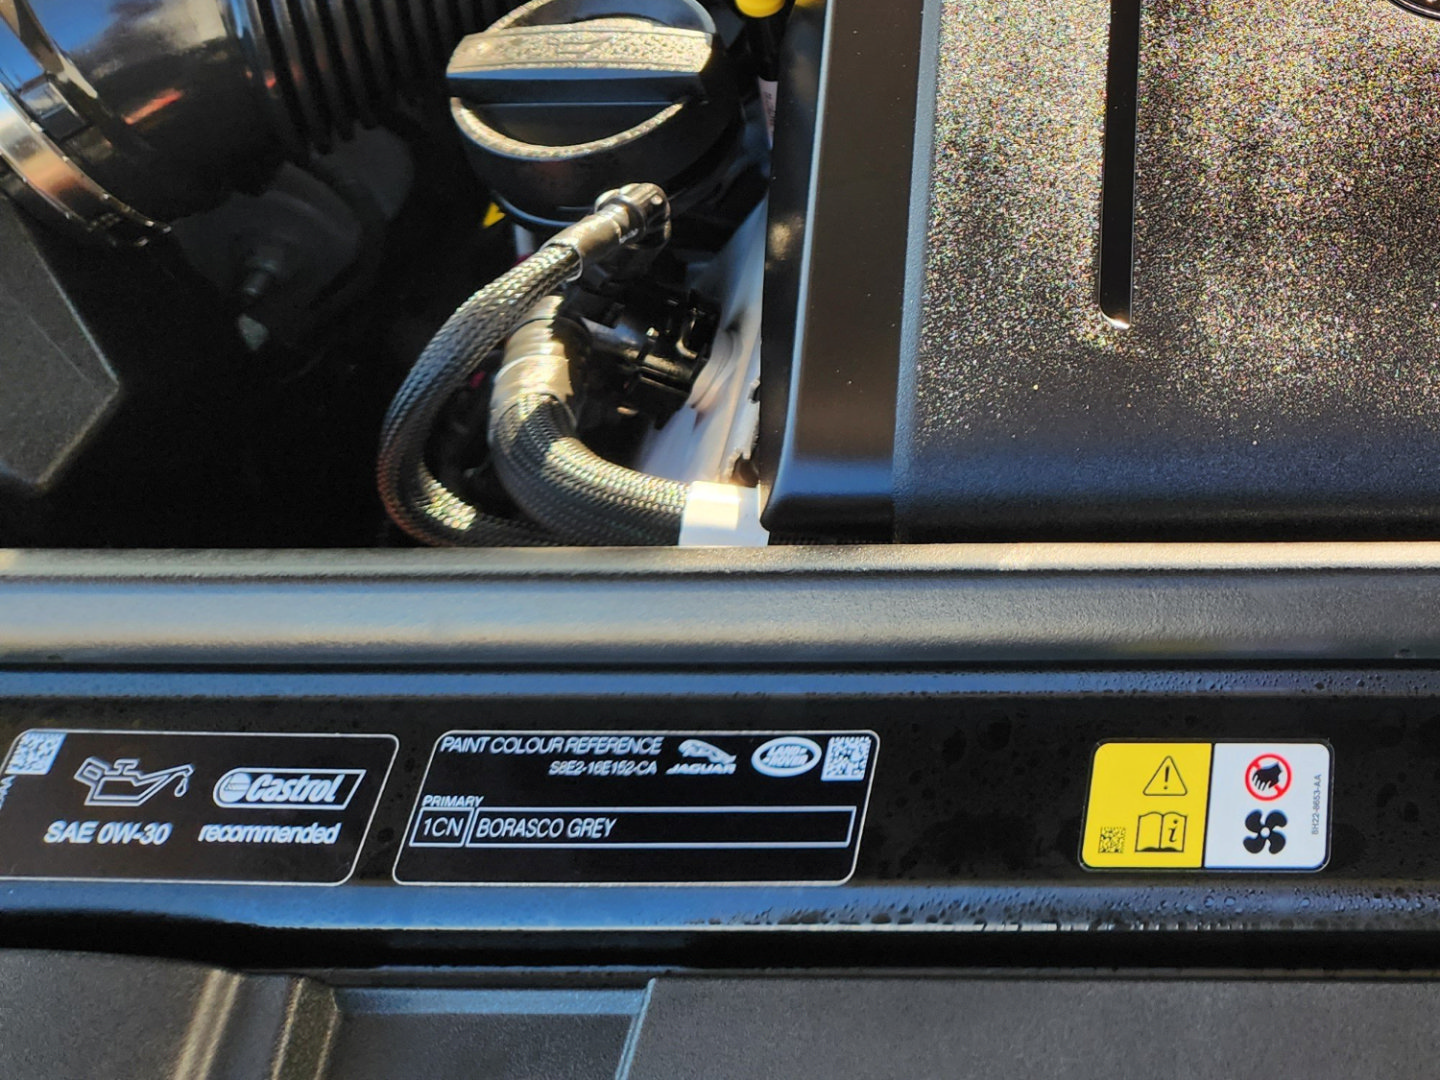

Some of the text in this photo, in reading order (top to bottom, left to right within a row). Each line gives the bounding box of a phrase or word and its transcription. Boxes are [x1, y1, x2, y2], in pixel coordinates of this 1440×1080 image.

[441, 737, 664, 755] PAINT COLOUR REFERENCE
[666, 763, 737, 775] JAGUAR
[245, 774, 346, 803] Castrol
[422, 795, 484, 807] PRIMARY
[44, 821, 173, 845] SAE 0W-30
[199, 823, 341, 845] recommended
[423, 817, 464, 837] 1CN
[476, 818, 617, 838] BORASCO GREY
